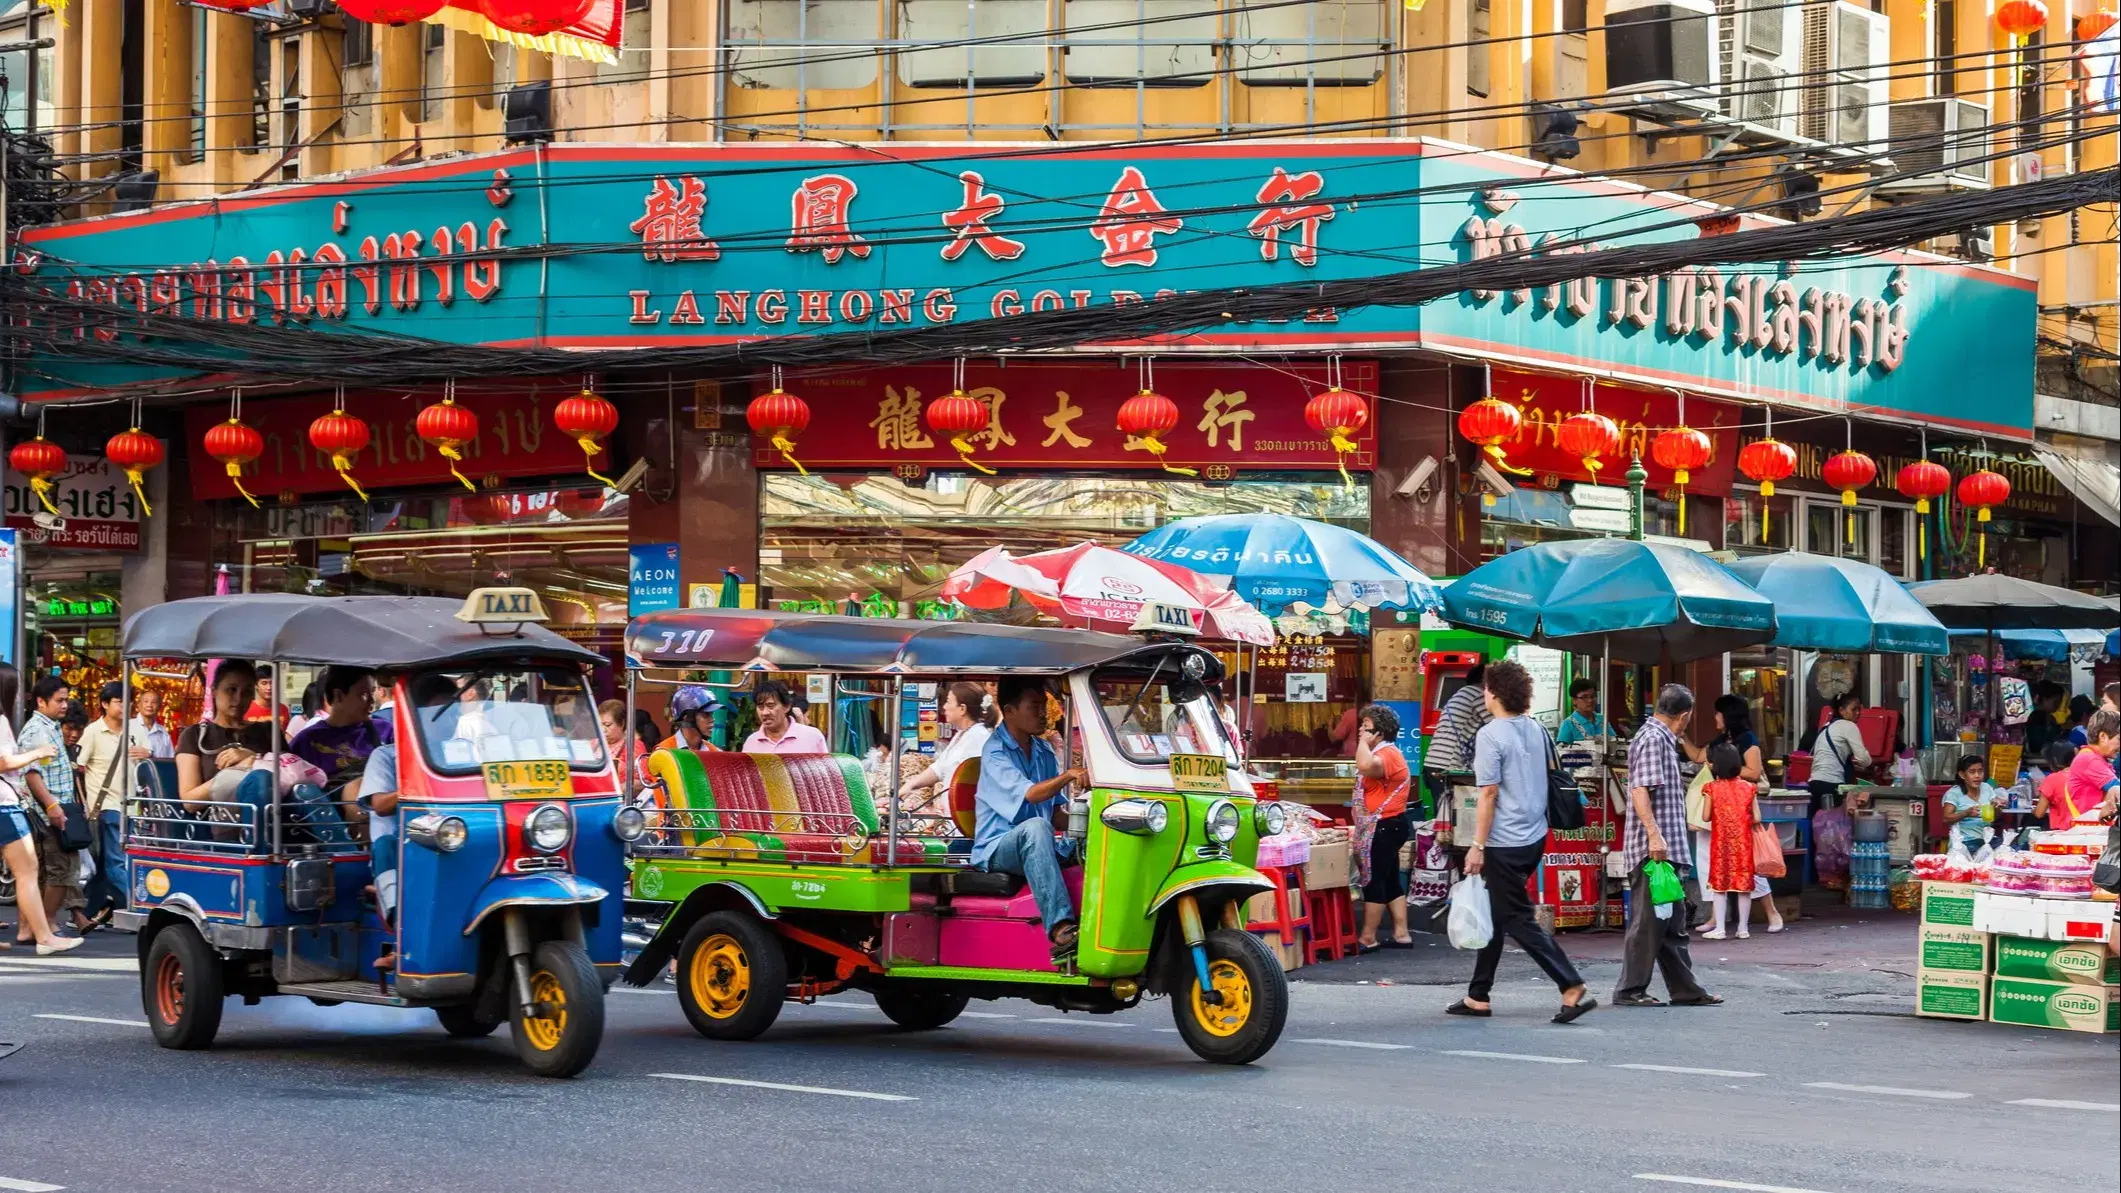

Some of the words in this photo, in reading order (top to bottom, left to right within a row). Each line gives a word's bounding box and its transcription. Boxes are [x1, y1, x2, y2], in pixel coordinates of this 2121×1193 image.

[629, 165, 1337, 268] 龍鳳大金行
[628, 288, 957, 323] LANGHONG
[634, 569, 676, 581] AEON
[634, 586, 673, 596] Welcome
[1252, 587, 1259, 595] 0
[1261, 587, 1284, 596] 2680
[1285, 587, 1309, 597] 3333
[483, 594, 533, 613] TAXI
[1155, 605, 1190, 626] TAXI
[1480, 608, 1508, 625] 1595
[654, 629, 715, 653] 310
[524, 763, 567, 782] 1858
[1196, 757, 1225, 777] 7204
[1911, 803, 1923, 815] 13
[2059, 955, 2097, 967] เอกชัย
[2058, 999, 2097, 1011] เอกชัย
